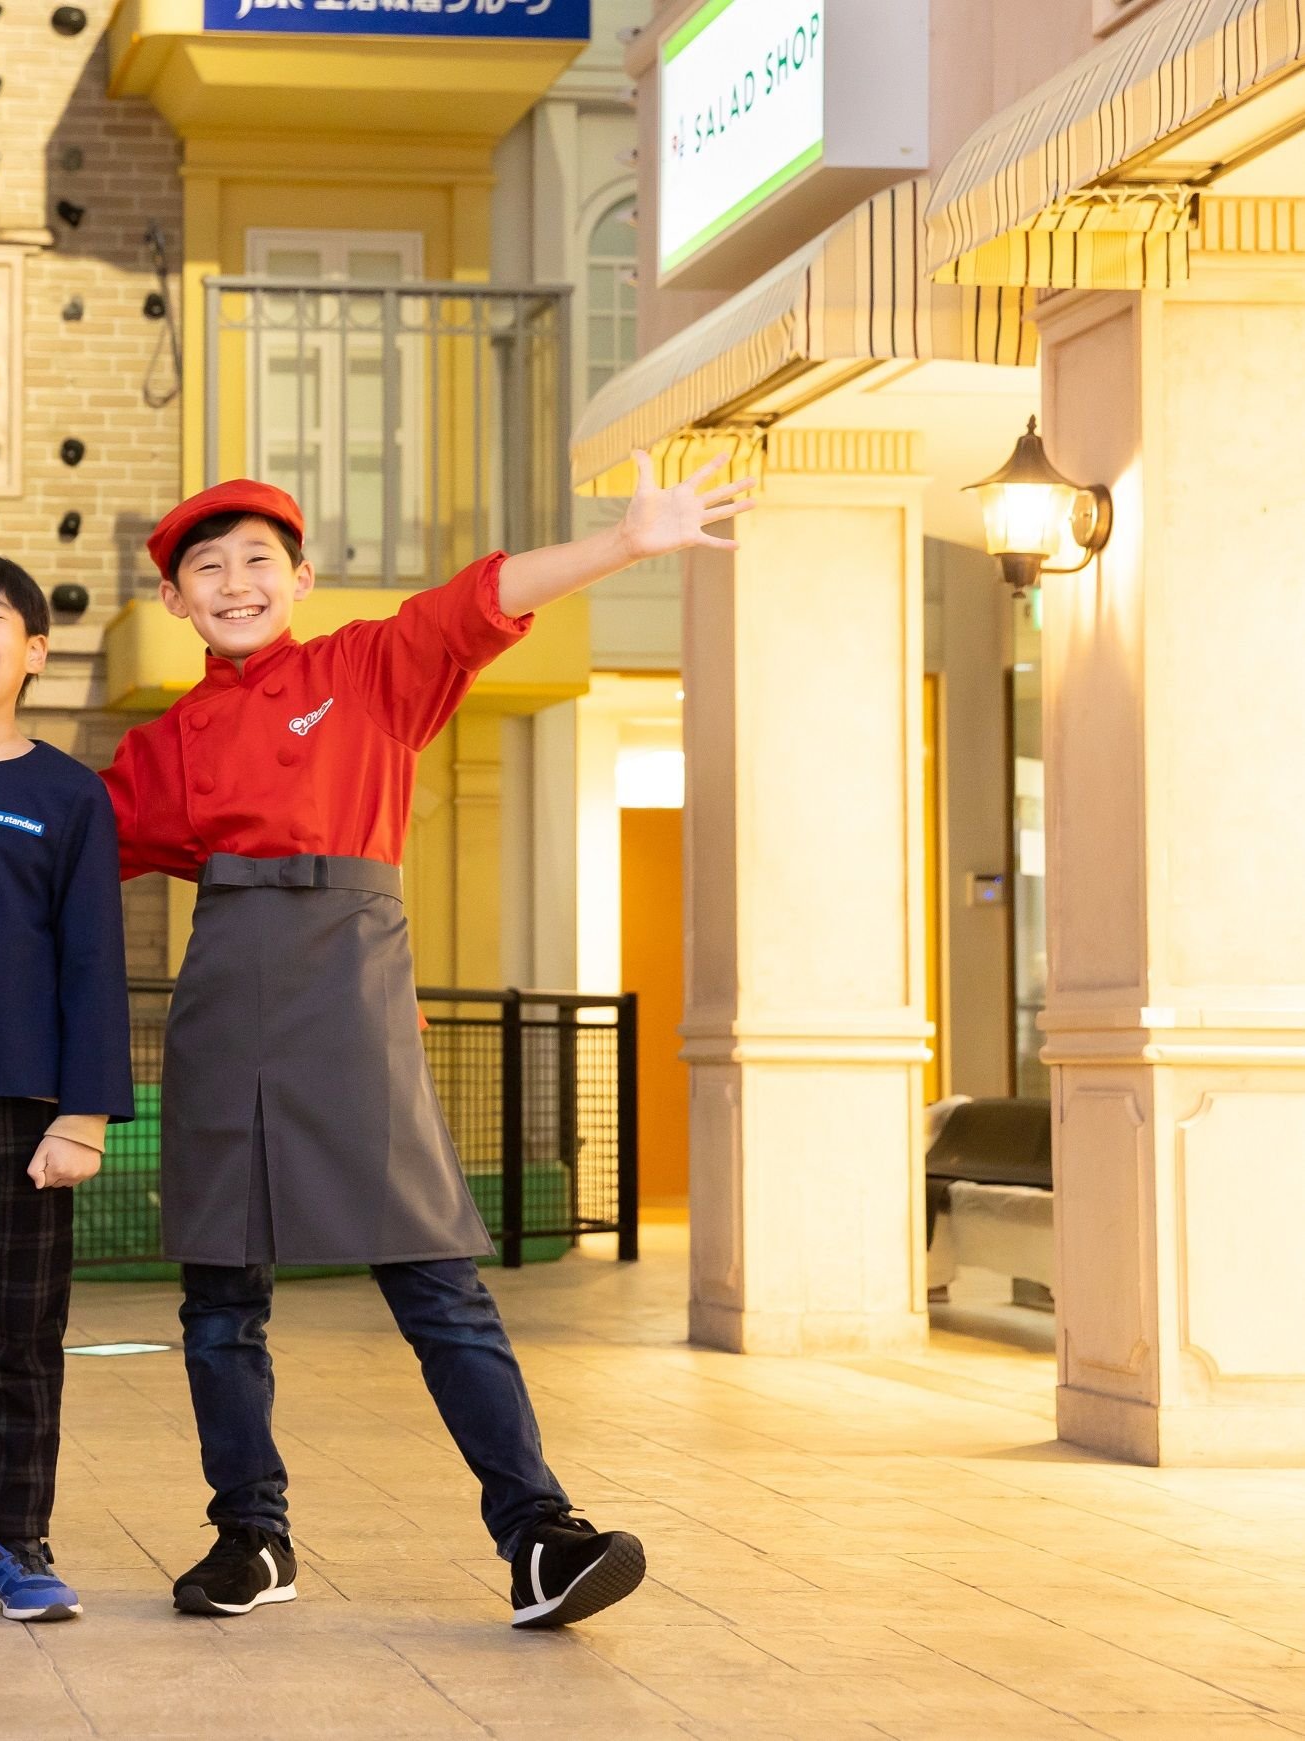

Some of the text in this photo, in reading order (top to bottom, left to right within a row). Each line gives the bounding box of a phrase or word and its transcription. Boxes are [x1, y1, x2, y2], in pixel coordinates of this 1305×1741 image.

[695, 12, 820, 153] SALAD SHOP
[4, 815, 42, 833] standard
